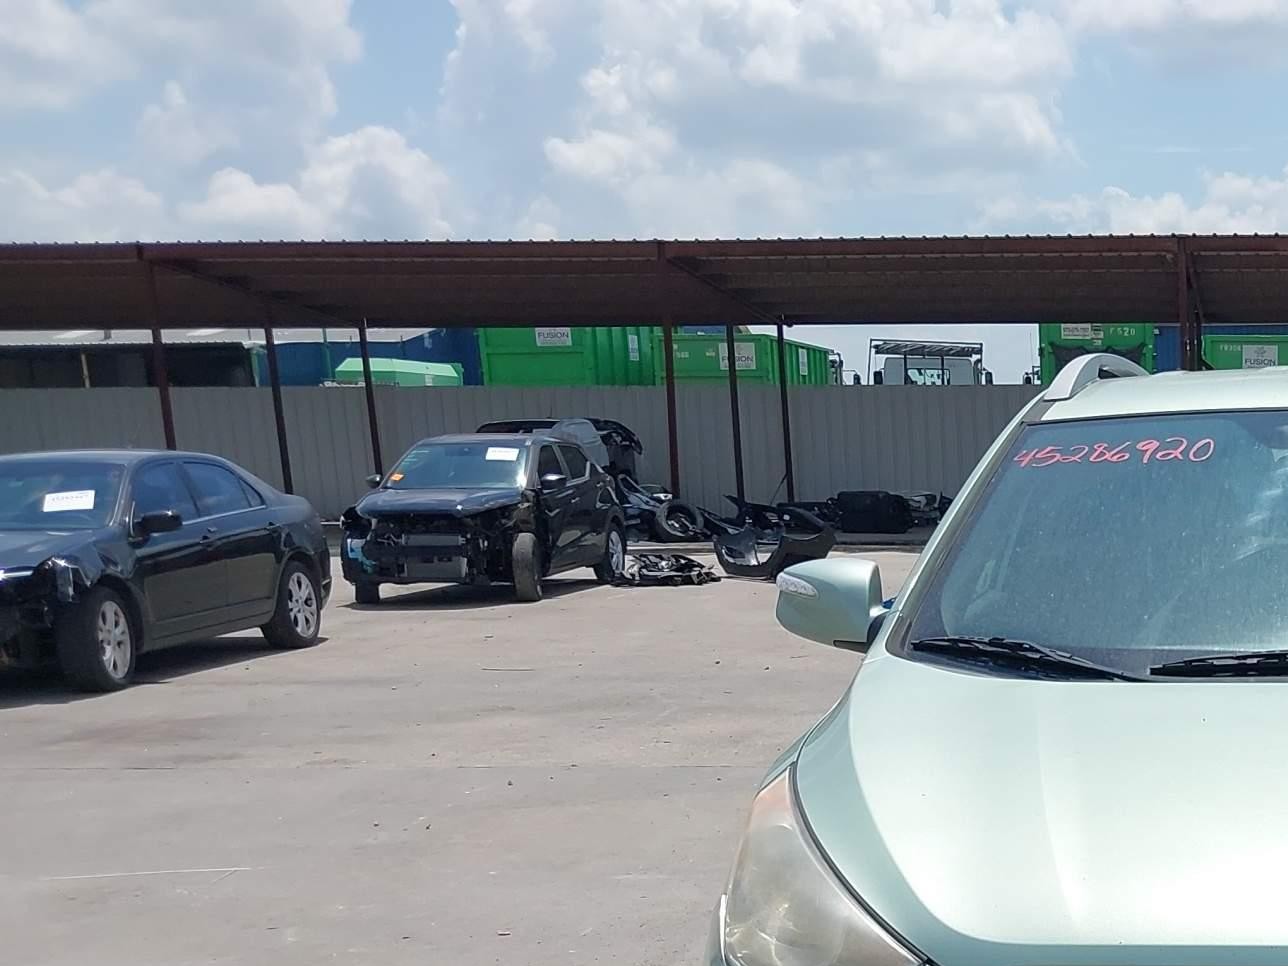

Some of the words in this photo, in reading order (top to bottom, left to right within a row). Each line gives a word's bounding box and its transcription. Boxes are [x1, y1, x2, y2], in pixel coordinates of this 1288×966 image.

[537, 331, 569, 339] FUSION
[1245, 358, 1276, 366] FUSION
[1013, 437, 1215, 467] 45286920
